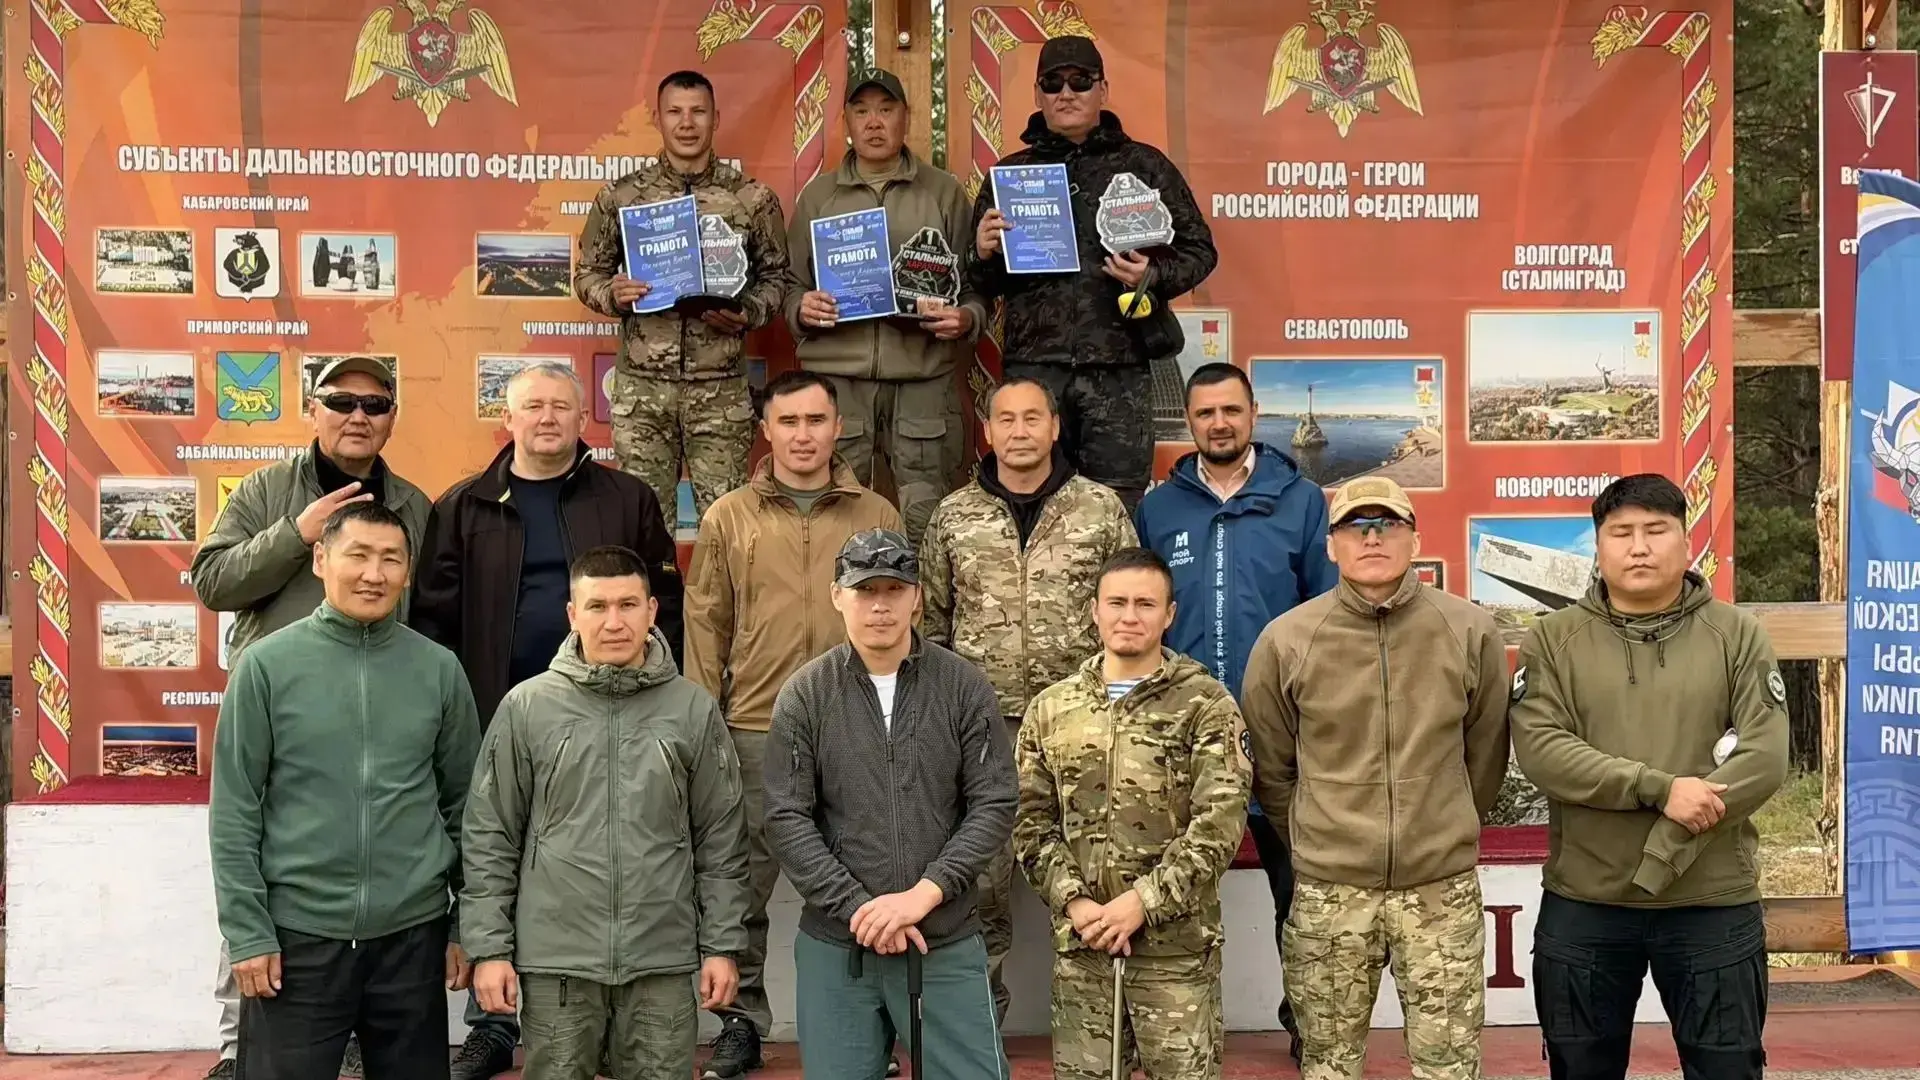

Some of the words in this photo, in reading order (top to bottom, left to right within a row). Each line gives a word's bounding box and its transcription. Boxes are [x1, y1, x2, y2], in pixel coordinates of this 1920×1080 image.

[118, 145, 240, 173] СУБЪЕКТЫ
[245, 147, 480, 178] ДАЛЬНЕВОСТОЧНОГО
[1119, 175, 1131, 189] 3
[1266, 162, 1348, 188] ГОРОДА
[1364, 162, 1425, 187] ГЕРОИ
[182, 195, 273, 211] ХАБАРОВСКИЙ
[277, 196, 310, 211] КРАЙ
[560, 201, 593, 215] АМУР
[1104, 193, 1155, 209] СТАЛЬНОЙ
[1212, 189, 1349, 218] РОССИЙСКОЙ
[1353, 192, 1479, 221] ФЕДЕРАЦИИ
[1011, 203, 1060, 217] ГРАМОТА
[705, 217, 717, 231] 2
[700, 238, 737, 248] ЛЬНОЙ
[926, 230, 933, 245] 1
[639, 236, 689, 257] ГРАМОТА
[827, 246, 878, 267] ГРАМОТА
[903, 250, 953, 267] СТАЛЬНОЙ
[1514, 244, 1613, 267] ВОЛГОГРАД
[1502, 269, 1626, 292] (СТАЛИНГРАД)
[187, 320, 272, 335] ПРИМОРСКИЙ
[276, 320, 309, 335] КРАЙ
[522, 321, 593, 336] ЧУКОТСКИЙ
[1284, 318, 1409, 340] СЕВАСТОПОЛЬ
[176, 444, 286, 460] ЗАБАЙКАЛЬСКИЙ
[1495, 472, 1621, 497] НОВОРОССИЙ
[1172, 548, 1190, 559] МОЙ
[1168, 556, 1195, 568] СПОРТ
[1217, 660, 1226, 685] порт
